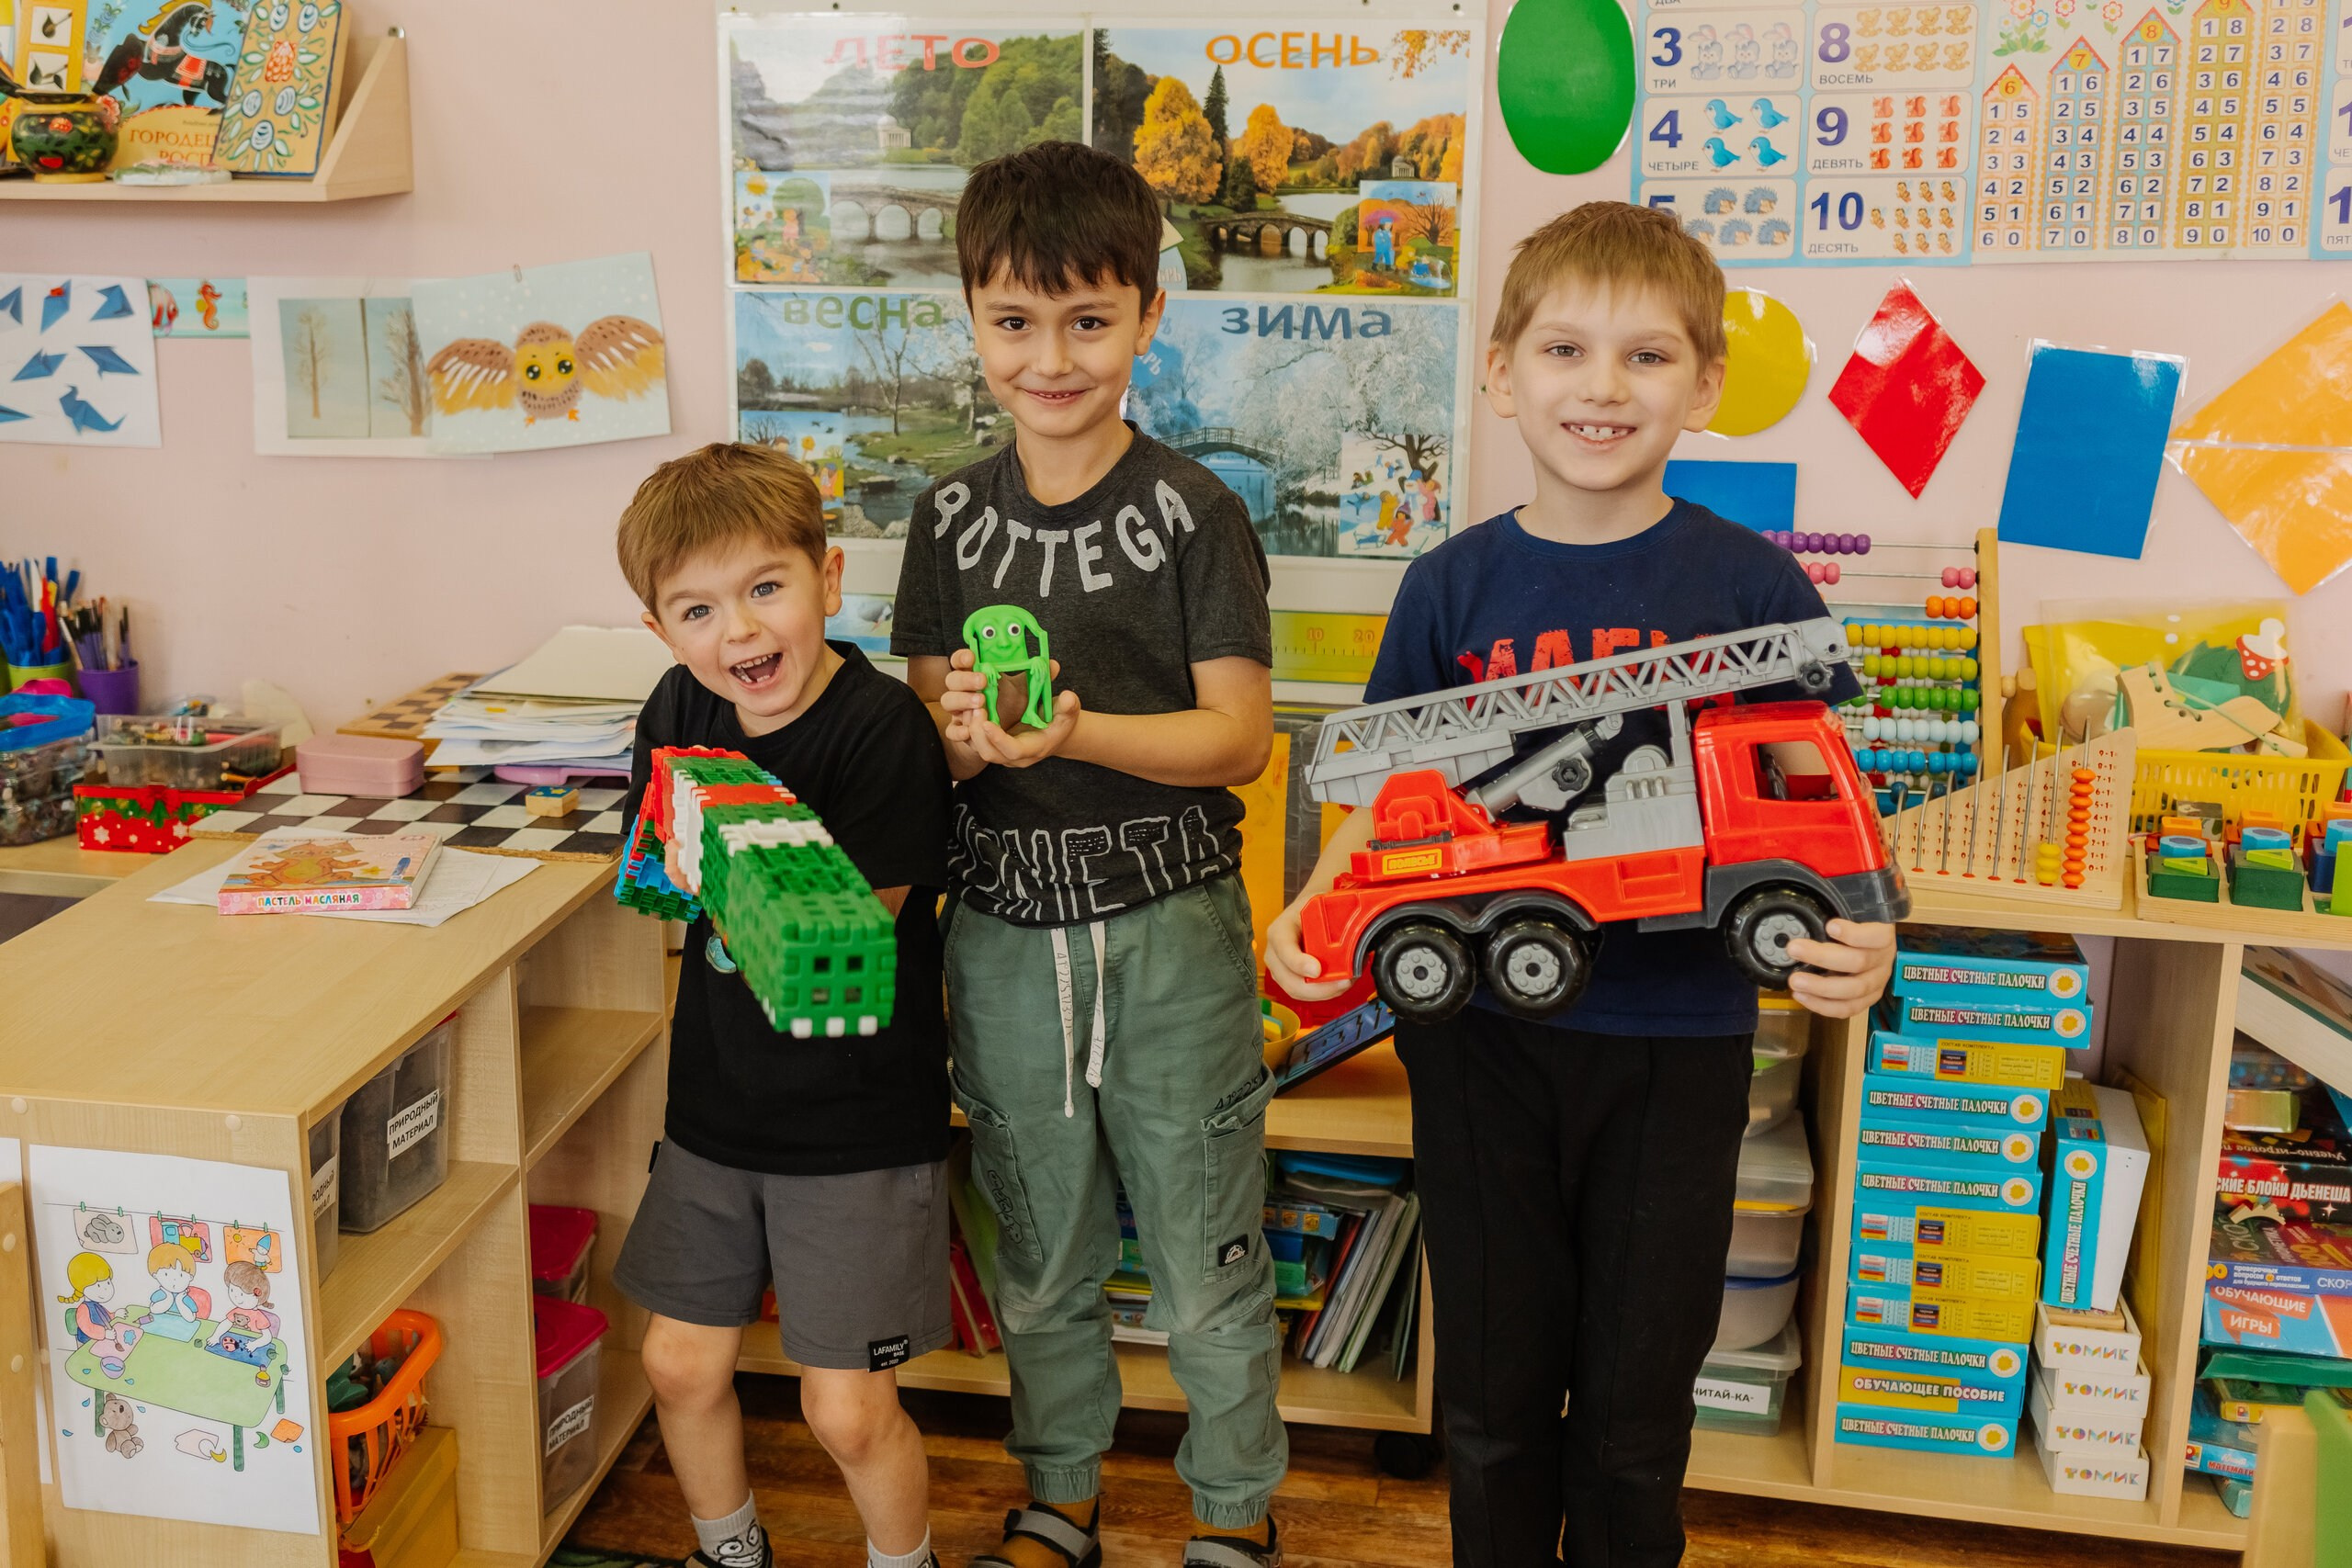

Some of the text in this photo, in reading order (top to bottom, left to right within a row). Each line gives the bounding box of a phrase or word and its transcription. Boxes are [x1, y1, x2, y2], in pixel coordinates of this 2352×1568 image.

[2146, 25, 2157, 39] 8
[2203, 19, 2243, 36] 1 8
[2271, 17, 2313, 33] 2 8
[1205, 31, 1379, 70] ОСЕНЬ
[1651, 28, 1683, 67] 3
[1818, 22, 1851, 63] 8
[823, 34, 1001, 71] ЛЕТО
[2075, 53, 2087, 67] 7
[2131, 48, 2170, 63] 1 7
[2199, 46, 2241, 62] 2 7
[2269, 44, 2311, 61] 3 7
[1653, 79, 1677, 89] ТРИ
[1819, 73, 1873, 85] ВОСЕМЬ
[2060, 75, 2098, 91] 1 6
[2128, 73, 2168, 90] 2 6
[2199, 73, 2239, 88] 3 6
[2267, 71, 2308, 86] 4 6
[2005, 80, 2017, 95] 6
[1990, 104, 2028, 118] 1 5
[2057, 102, 2096, 118] 2 5
[2127, 100, 2166, 116] 3 5
[2196, 99, 2236, 115] 4 5
[2266, 97, 2306, 114] 5 5
[1649, 109, 1683, 149] 4
[1816, 107, 1849, 146] 9
[2123, 127, 2164, 142] 4 4
[2194, 126, 2233, 141] 5 4
[2263, 124, 2303, 140] 6 4
[1988, 130, 2027, 144] 2 4
[2055, 129, 2094, 144] 3 4
[1813, 158, 1863, 171] ДЕВЯТЬ
[1987, 155, 2025, 170] 3 3
[2053, 153, 2092, 169] 4 3
[2122, 152, 2162, 168] 5 3
[2192, 152, 2232, 167] 6 3
[2261, 150, 2301, 165] 7 3
[1648, 160, 1699, 172] ЧЕТЫРЕ
[1984, 181, 2023, 196] 4 2
[2052, 179, 2089, 194] 5 2
[2120, 178, 2160, 194] 6 2
[2190, 177, 2229, 192] 7 2
[2259, 175, 2299, 191] 8 2
[1811, 191, 1864, 231] 10
[1984, 206, 2018, 221] 5 1
[2050, 205, 2085, 220] 6 1
[2119, 204, 2154, 219] 7 1
[2188, 202, 2224, 218] 8 1
[2256, 202, 2294, 217] 9 1
[1982, 231, 2020, 246] 6 0
[2048, 230, 2086, 244] 7 0
[2117, 229, 2155, 244] 8 0
[2187, 228, 2225, 243] 9 0
[2252, 227, 2295, 243] 10 0
[1808, 243, 1859, 254] ДЕСЯТЬ
[934, 479, 1195, 598] BOTTEGA
[1306, 626, 1375, 643] 10 20
[257, 894, 360, 907] ПАСТЕЛЬ МАСЛЯНАЯ
[1904, 965, 2046, 989] ЦВЕТНЫЕ СЧЕТНЫЕ ПАЛОЧКИ
[1911, 1008, 2051, 1030] ЦВЕТНЫЕ СЧЕТНЫЕ ПАЛОЧКИ
[1870, 1091, 2007, 1114] ЦВЕТНЫЕ СЧЕТНЫЕ ПАЛОЧКИ
[389, 1092, 438, 1136] ПРИРОДНЫЙ
[392, 1114, 434, 1150] МАТЕРИАЛ
[1862, 1130, 1999, 1154] ЦВЕТНЫЕ СЧЕТНЫЕ ПАЛОЧКИ
[1862, 1174, 1999, 1198] ЦВЕТНЫЕ СЧЕТНЫЕ ПАЛОЧКИ
[2246, 1179, 2289, 1197] БЛОКИ
[2290, 1181, 2352, 1202] ДЬЕНЕША
[2061, 1181, 2086, 1303] ЦВЕТНЫЕ СЧЕТНЫЕ ПАЛОЧКИ
[2214, 1285, 2306, 1314] ОБУЧАЮЩИЕ
[2230, 1314, 2273, 1335] ИГРЫ
[873, 1343, 905, 1356] LAFAMILY
[1850, 1341, 1986, 1368] ЦВЕТНЫЕ СЧЕТНЫЕ ПАЛОЧКИ
[2053, 1341, 2131, 1360] ТОМИК
[1853, 1378, 2005, 1403] ОБУЧАЮЩЕЕ ПОСОБИЕ
[2064, 1382, 2140, 1401] ТОМИК
[1841, 1418, 1975, 1443] ЦВЕТНЫЕ СЧЕТНЫЕ ПАЛОЧКИ
[2056, 1426, 2136, 1446] ТОМИК
[2065, 1467, 2140, 1485] ТОМИК
